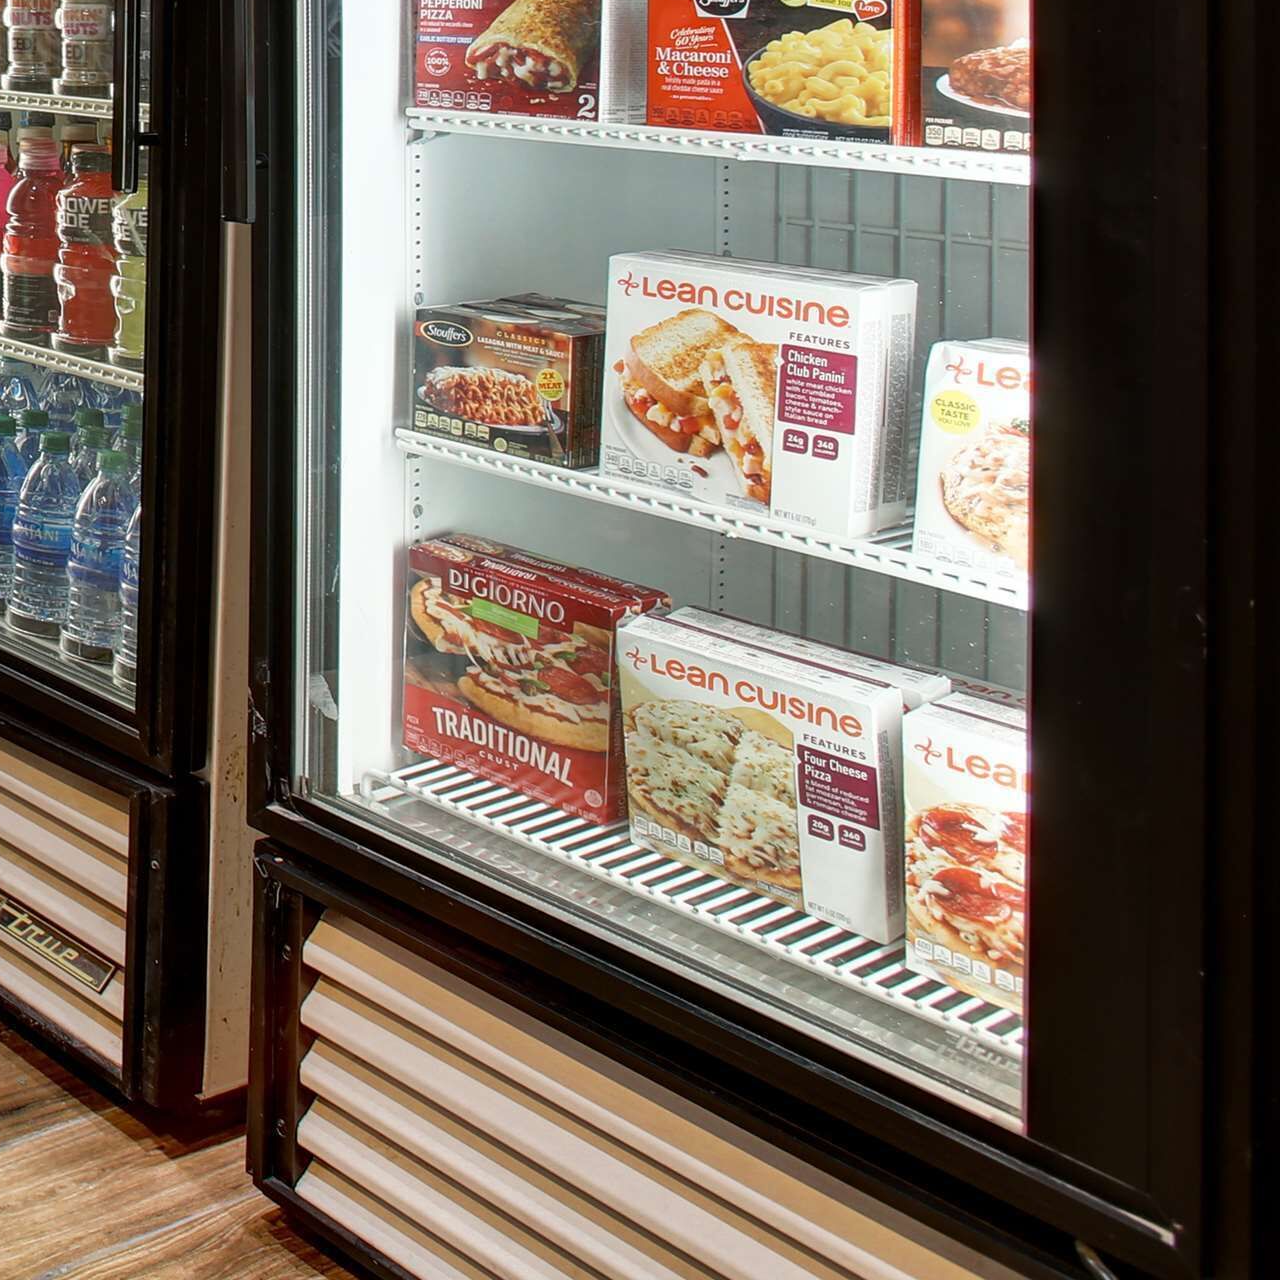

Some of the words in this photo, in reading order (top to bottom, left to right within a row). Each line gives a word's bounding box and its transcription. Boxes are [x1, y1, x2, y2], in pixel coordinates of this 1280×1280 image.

[421, 10, 453, 20] PIZZA
[859, 2, 881, 13] Love
[670, 26, 716, 39] Celebrating
[691, 34, 714, 44] Years
[427, 57, 449, 66] 100%
[655, 47, 732, 64] Macaroni
[657, 62, 670, 75] &
[673, 62, 729, 78] Cheese
[577, 95, 596, 118] 2
[426, 324, 468, 344] Stouffer's
[496, 331, 547, 346] CLASSICS
[789, 332, 851, 350] FEATURES
[505, 341, 521, 351] WITH
[787, 349, 828, 367] Chicken
[542, 372, 555, 380] 2X
[787, 363, 810, 378] Club
[812, 368, 845, 384] Panini
[539, 382, 563, 391] MEAT
[786, 378, 804, 387] white
[805, 381, 824, 391] meat
[825, 385, 853, 395] chicken
[802, 387, 836, 399] crumbled
[785, 399, 810, 409] cheese
[935, 398, 976, 413] CLASSIC
[785, 406, 802, 415] style
[803, 409, 823, 419] sauce
[940, 408, 970, 421] TASTE
[807, 416, 828, 426] bread
[787, 433, 804, 445] 24g
[432, 706, 574, 788] TRADITIONAL
[803, 733, 867, 761] FEATURES
[479, 749, 520, 771] CRUST
[804, 751, 827, 768] Four
[829, 759, 869, 781] Cheese
[804, 765, 832, 783] Pizza
[811, 780, 830, 791] blend
[840, 789, 870, 804] reduced
[812, 820, 829, 832] 20g
